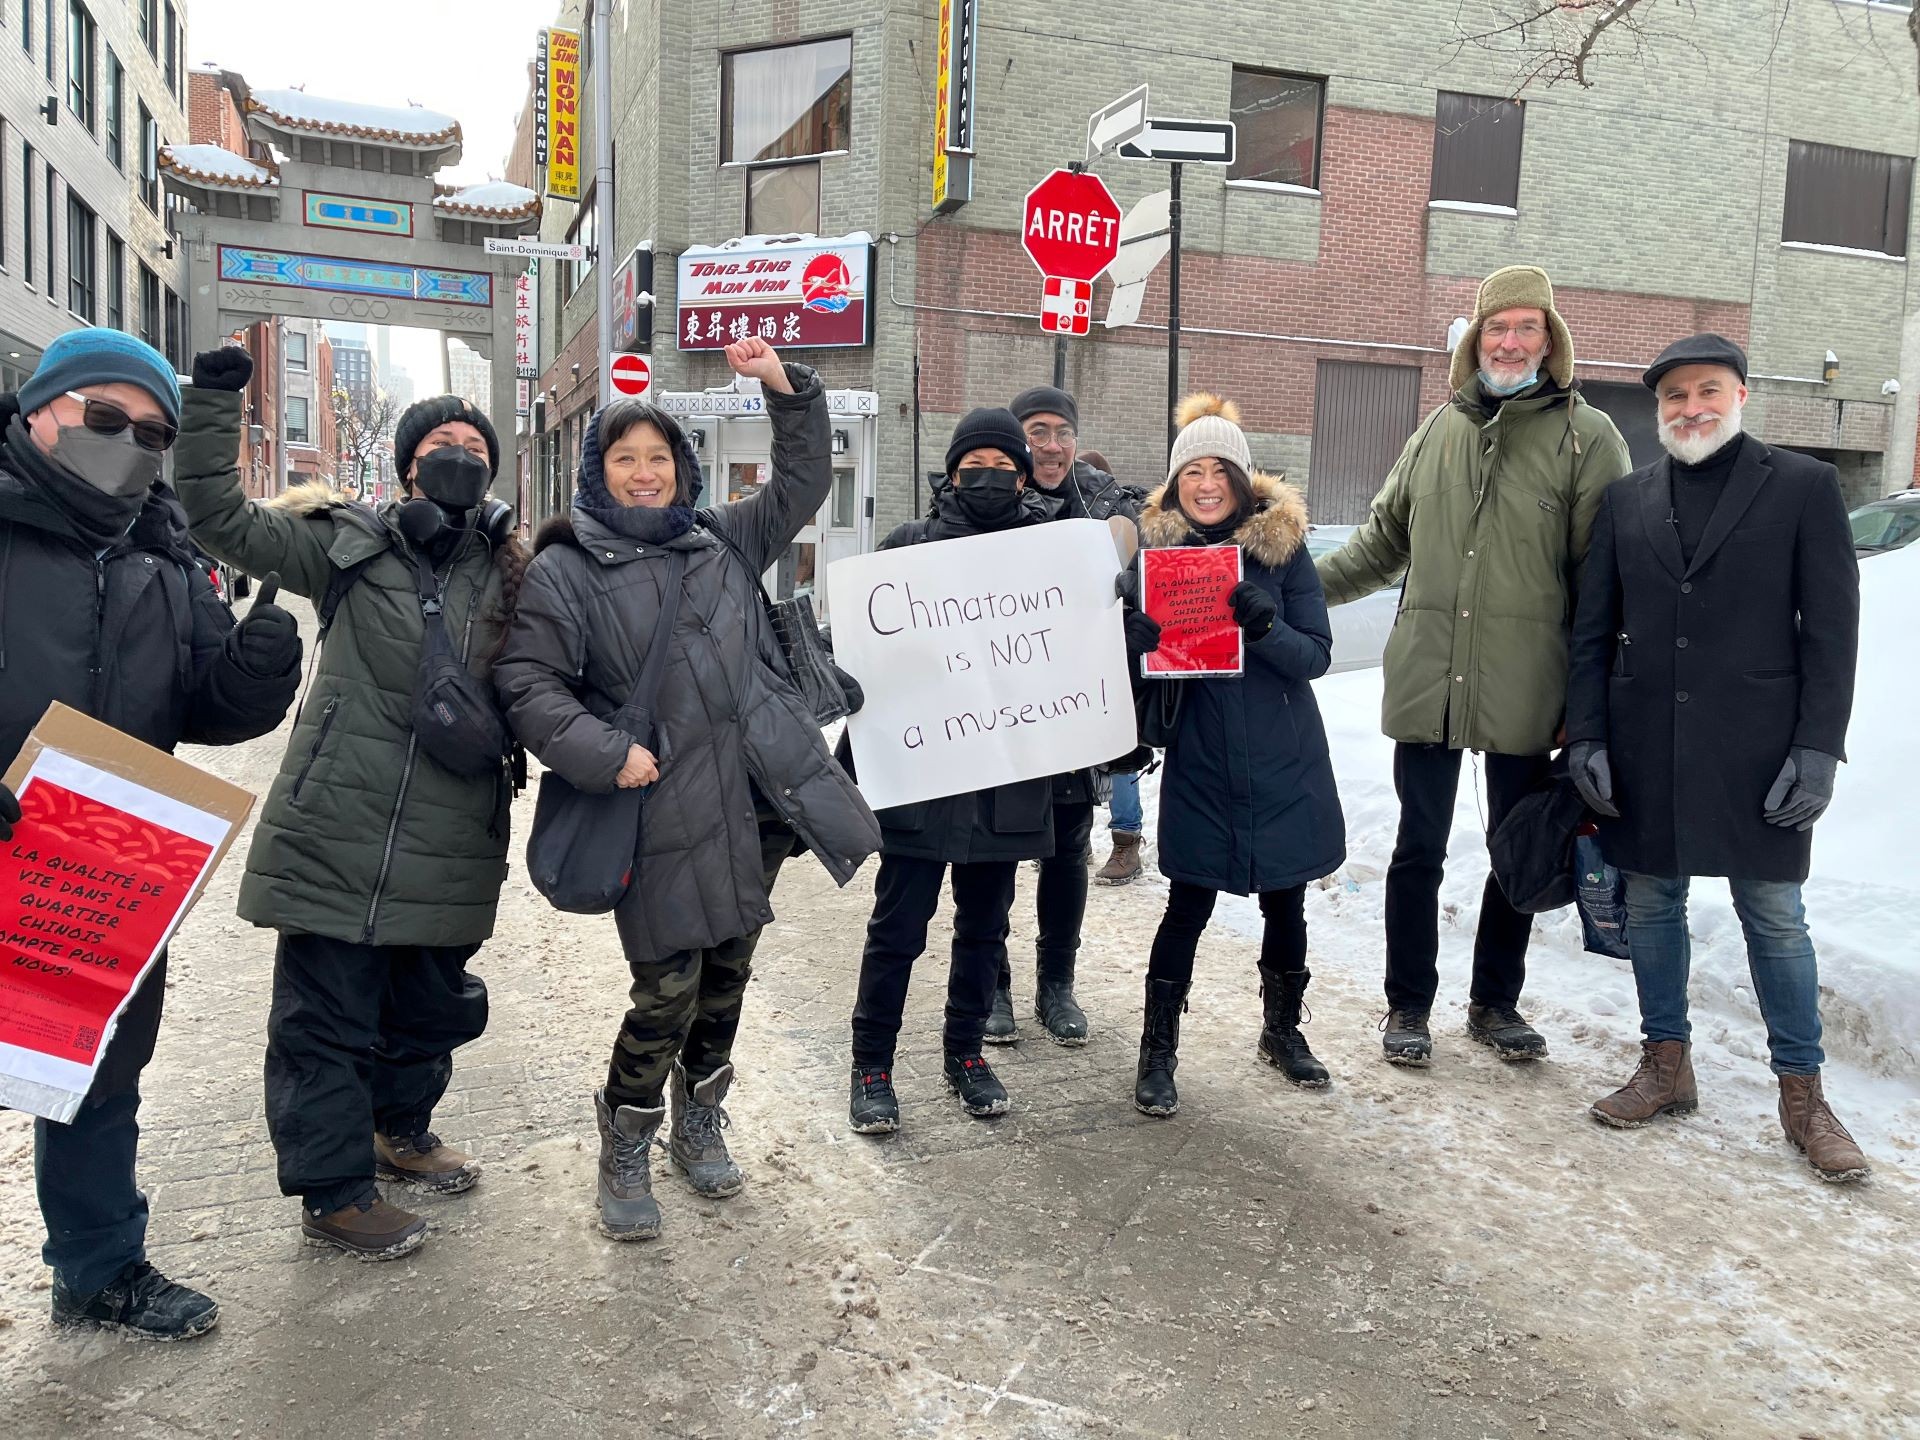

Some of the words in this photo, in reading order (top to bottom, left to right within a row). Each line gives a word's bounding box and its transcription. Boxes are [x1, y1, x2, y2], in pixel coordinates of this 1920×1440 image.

[551, 33, 579, 49] TONG
[940, 4, 949, 76] MON
[536, 34, 547, 162] RESTAURANT
[556, 68, 574, 115] MON
[937, 83, 946, 157] NAN
[556, 119, 574, 166] NAN
[1028, 207, 1117, 248] ARRÊT
[489, 243, 569, 257] Saint-Dominique
[689, 261, 739, 277] TONG
[737, 259, 791, 275] SING
[701, 281, 747, 295] MON
[748, 279, 790, 292] NAN
[684, 311, 801, 344] 東昇樓酒家
[742, 397, 761, 410] 43
[1163, 590, 1178, 598] VIE
[1182, 587, 1206, 596] DANS
[1210, 585, 1222, 593] LE
[1169, 596, 1217, 607] QUARTIER
[868, 582, 1064, 636] Chinatown
[1161, 618, 1199, 628] COMPTE
[1202, 614, 1229, 624] POUR
[1173, 606, 1214, 616] CHINOIS
[1182, 627, 1209, 635] NOUS!
[945, 651, 971, 673] is
[990, 628, 1052, 667] NOT
[903, 725, 924, 749] a
[11, 845, 39, 862] LA
[46, 856, 137, 889] QUALITÉ
[139, 881, 165, 897] DE
[19, 869, 55, 888] VIE
[59, 880, 113, 903] DANS
[116, 896, 142, 912] LE
[20, 893, 120, 928] QUARTIER
[19, 915, 106, 944] CHINOIS
[12, 956, 73, 978] NOUS!
[69, 948, 120, 970] POUR
